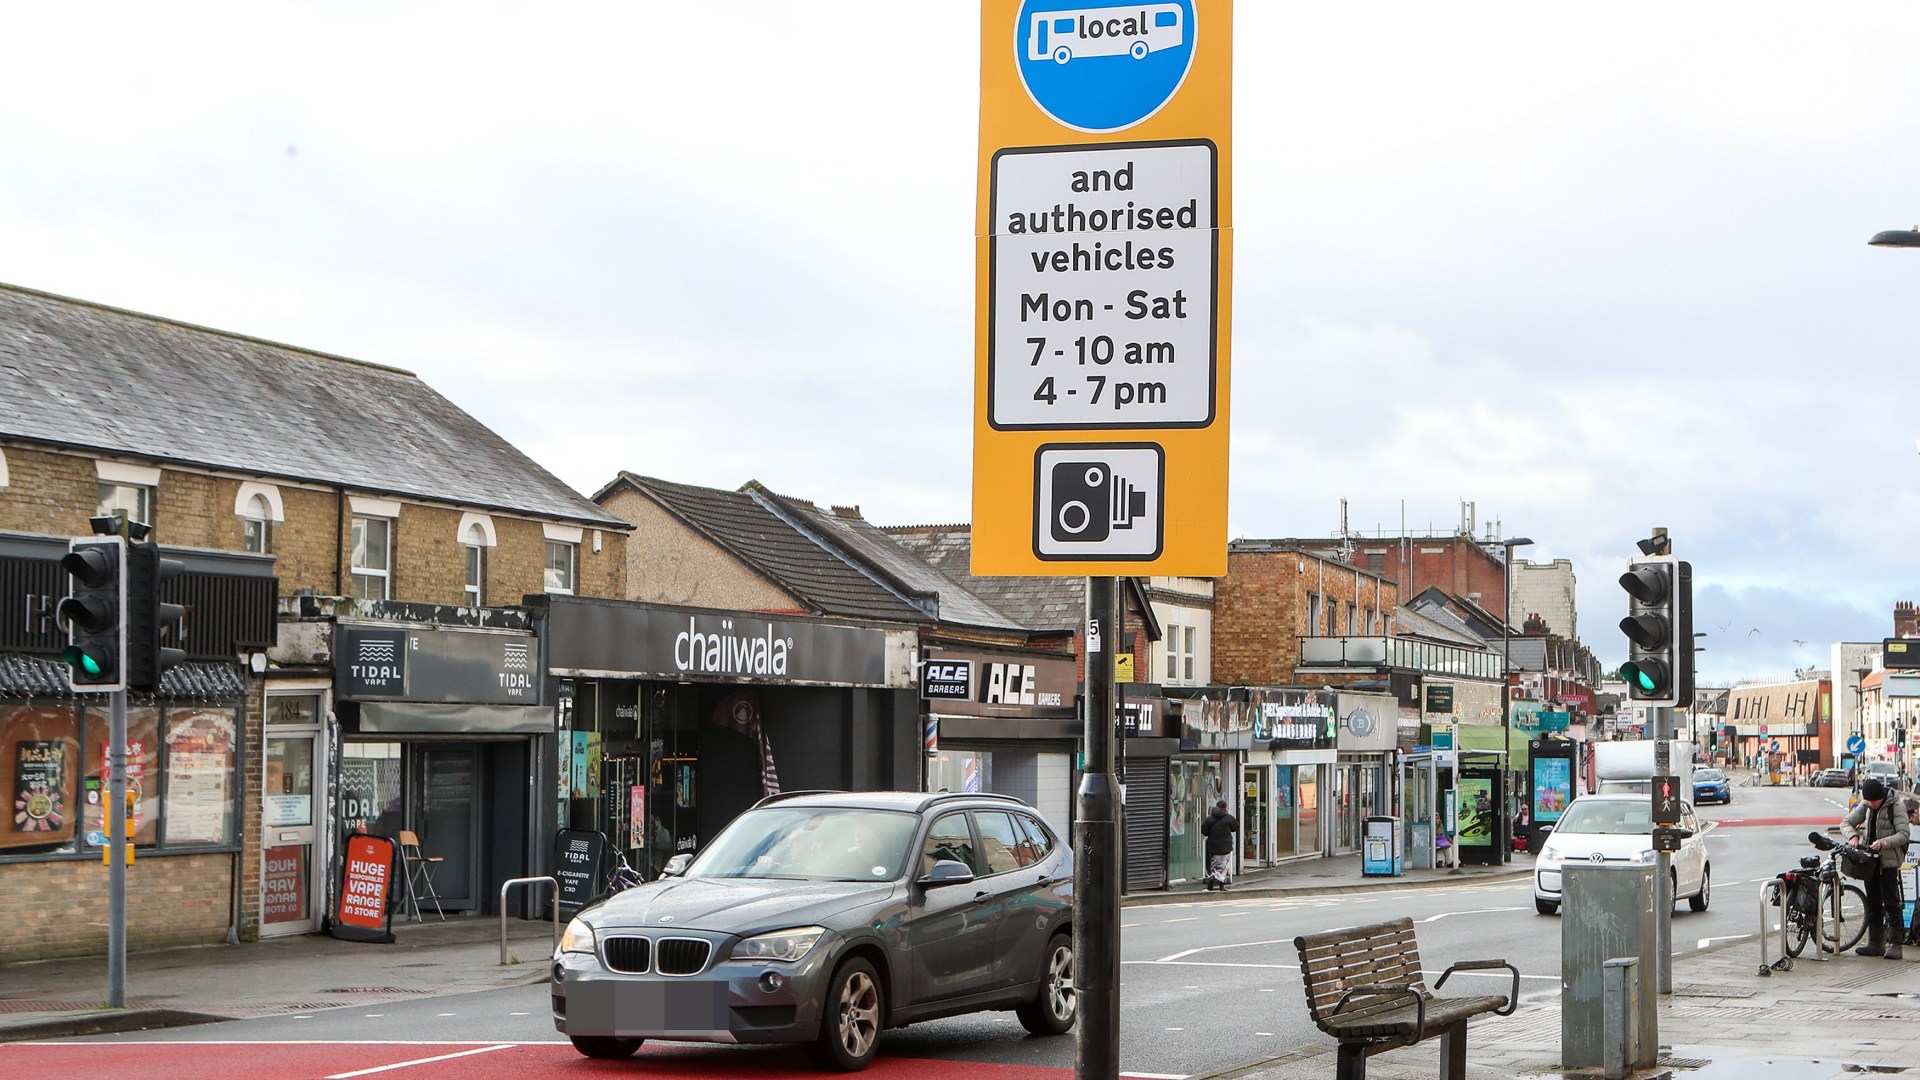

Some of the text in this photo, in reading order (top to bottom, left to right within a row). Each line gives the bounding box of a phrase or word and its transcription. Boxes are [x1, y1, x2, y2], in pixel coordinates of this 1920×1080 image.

[1079, 11, 1148, 39] local
[1070, 161, 1134, 193] and
[1008, 199, 1196, 233] authorised
[1031, 241, 1175, 273] vehicles
[1020, 293, 1094, 322] Mon
[1124, 289, 1187, 320] Sat
[1074, 335, 1114, 365] 10
[1124, 341, 1175, 365] am
[1114, 381, 1167, 410] pm
[1089, 620, 1099, 636] 5
[350, 665, 401, 679] TIDAL
[498, 673, 532, 688] TIDAL
[926, 664, 968, 681] ACE
[364, 677, 387, 686] VAPE
[928, 684, 965, 694] BARBERS
[986, 662, 1036, 705] ACE
[507, 688, 523, 696] VAPE
[281, 701, 301, 721] 184
[1357, 718, 1365, 729] B
[342, 798, 378, 818] IDAL
[344, 819, 367, 830] VAPE
[564, 851, 590, 861] TIDAL
[350, 860, 386, 877] HUGE
[557, 870, 590, 879] E-CIGARETTE
[349, 879, 383, 897] VAPE
[564, 878, 579, 886] VAPE
[354, 907, 380, 918] STORE
